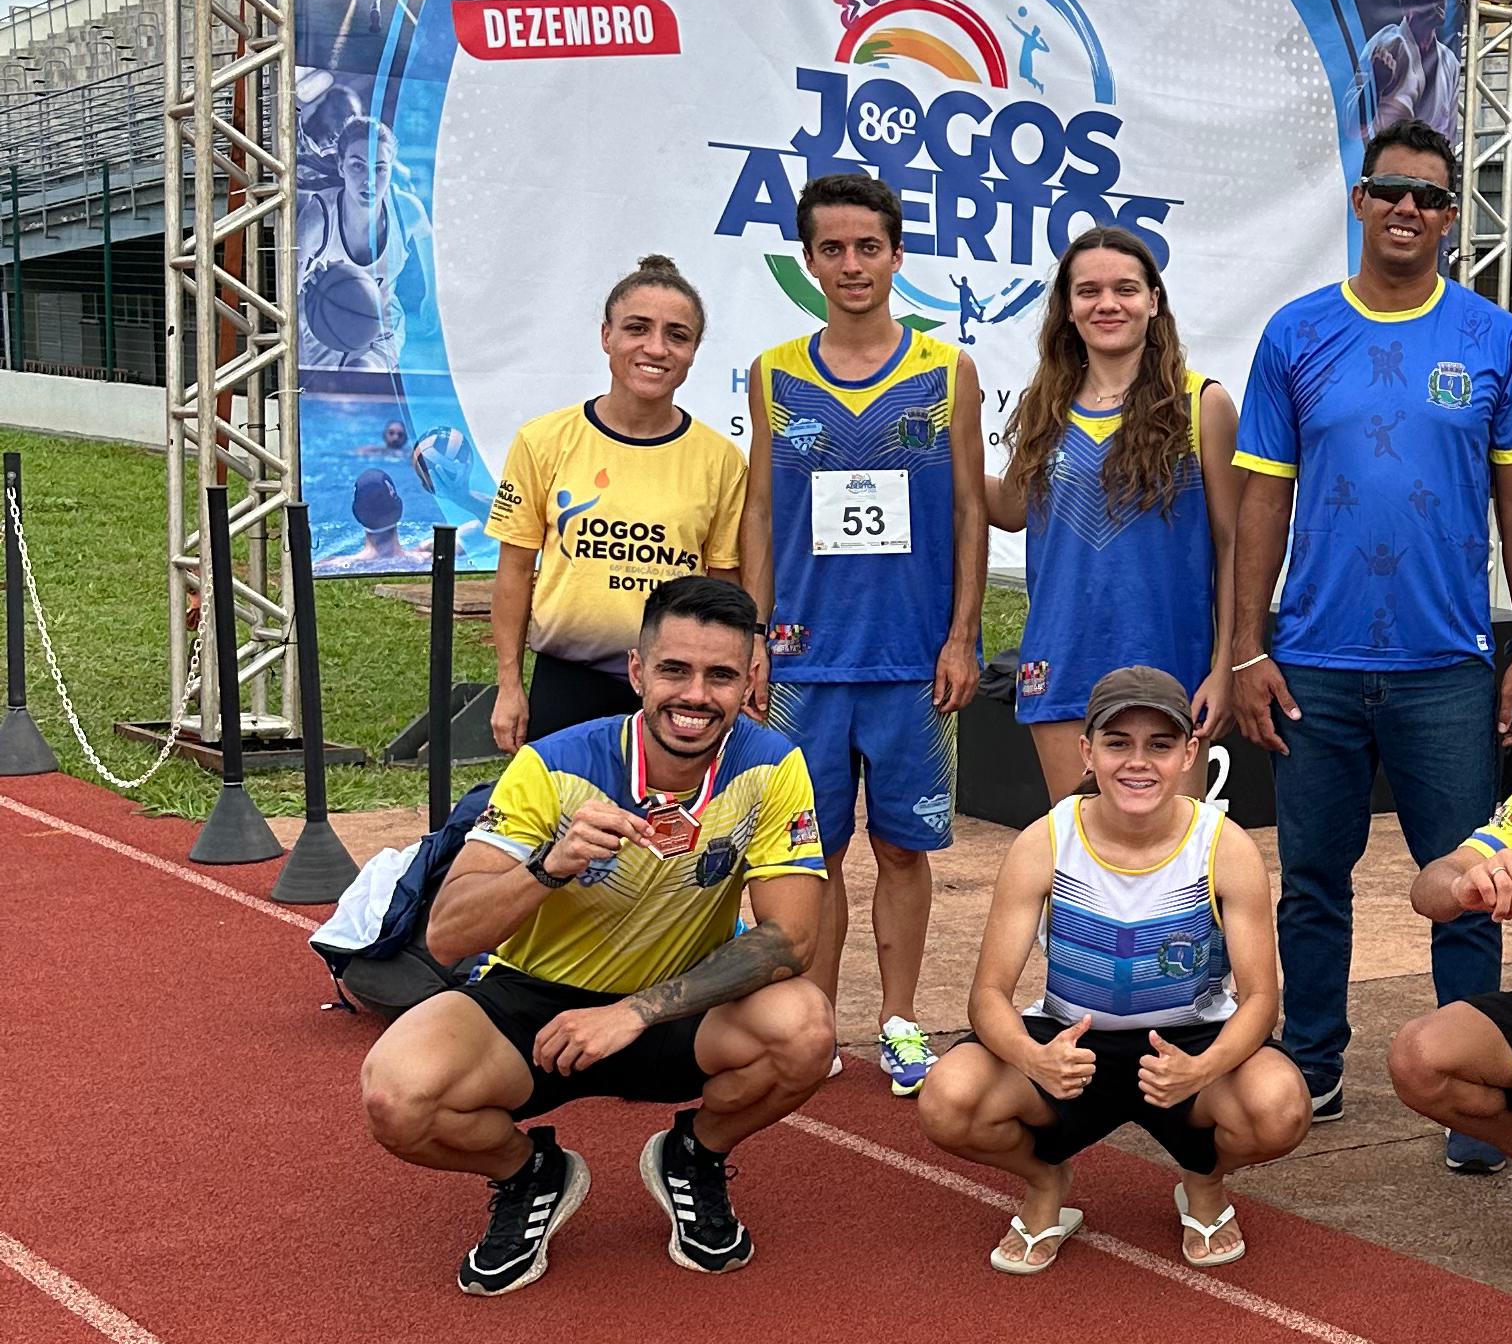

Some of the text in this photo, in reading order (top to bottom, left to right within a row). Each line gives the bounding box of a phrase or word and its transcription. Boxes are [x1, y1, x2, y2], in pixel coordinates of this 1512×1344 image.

[483, 5, 655, 49] DEZEMBRO
[790, 67, 1124, 193] JOGOS
[714, 149, 1171, 275] AERTOS
[577, 517, 667, 543] JOGOS
[842, 505, 886, 536] 53
[609, 575, 662, 592] BOTU
[1206, 745, 1231, 813] 2
